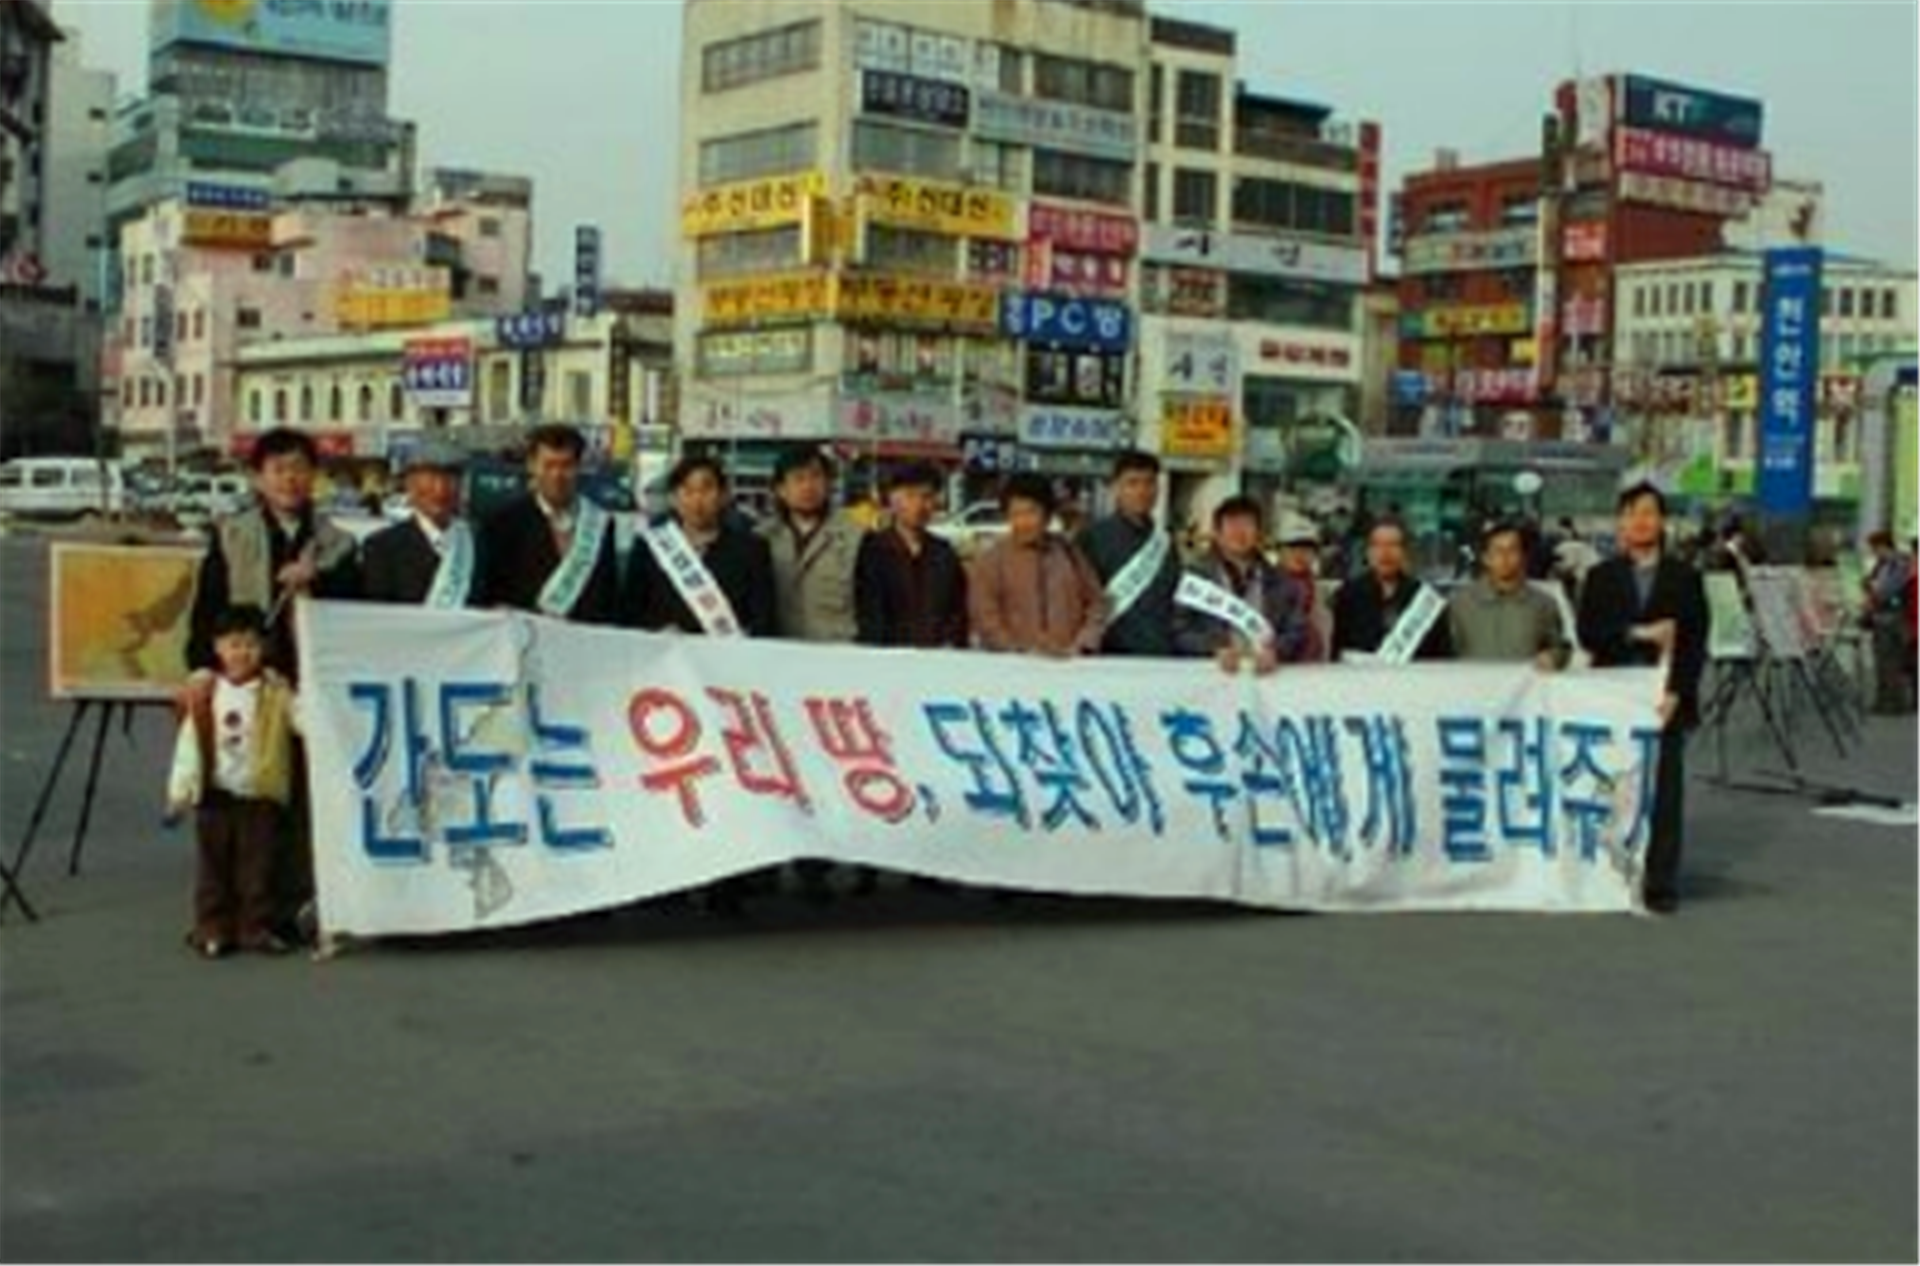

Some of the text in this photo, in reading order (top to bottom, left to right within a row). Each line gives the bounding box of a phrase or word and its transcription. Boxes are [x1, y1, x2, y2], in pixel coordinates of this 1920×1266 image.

[1654, 91, 1694, 123] KT
[1771, 296, 1805, 429] 천안역
[347, 676, 615, 864] 간도는
[627, 685, 814, 829] 우리
[922, 696, 1168, 837] 되찾아
[1157, 707, 1419, 862] 후손에게
